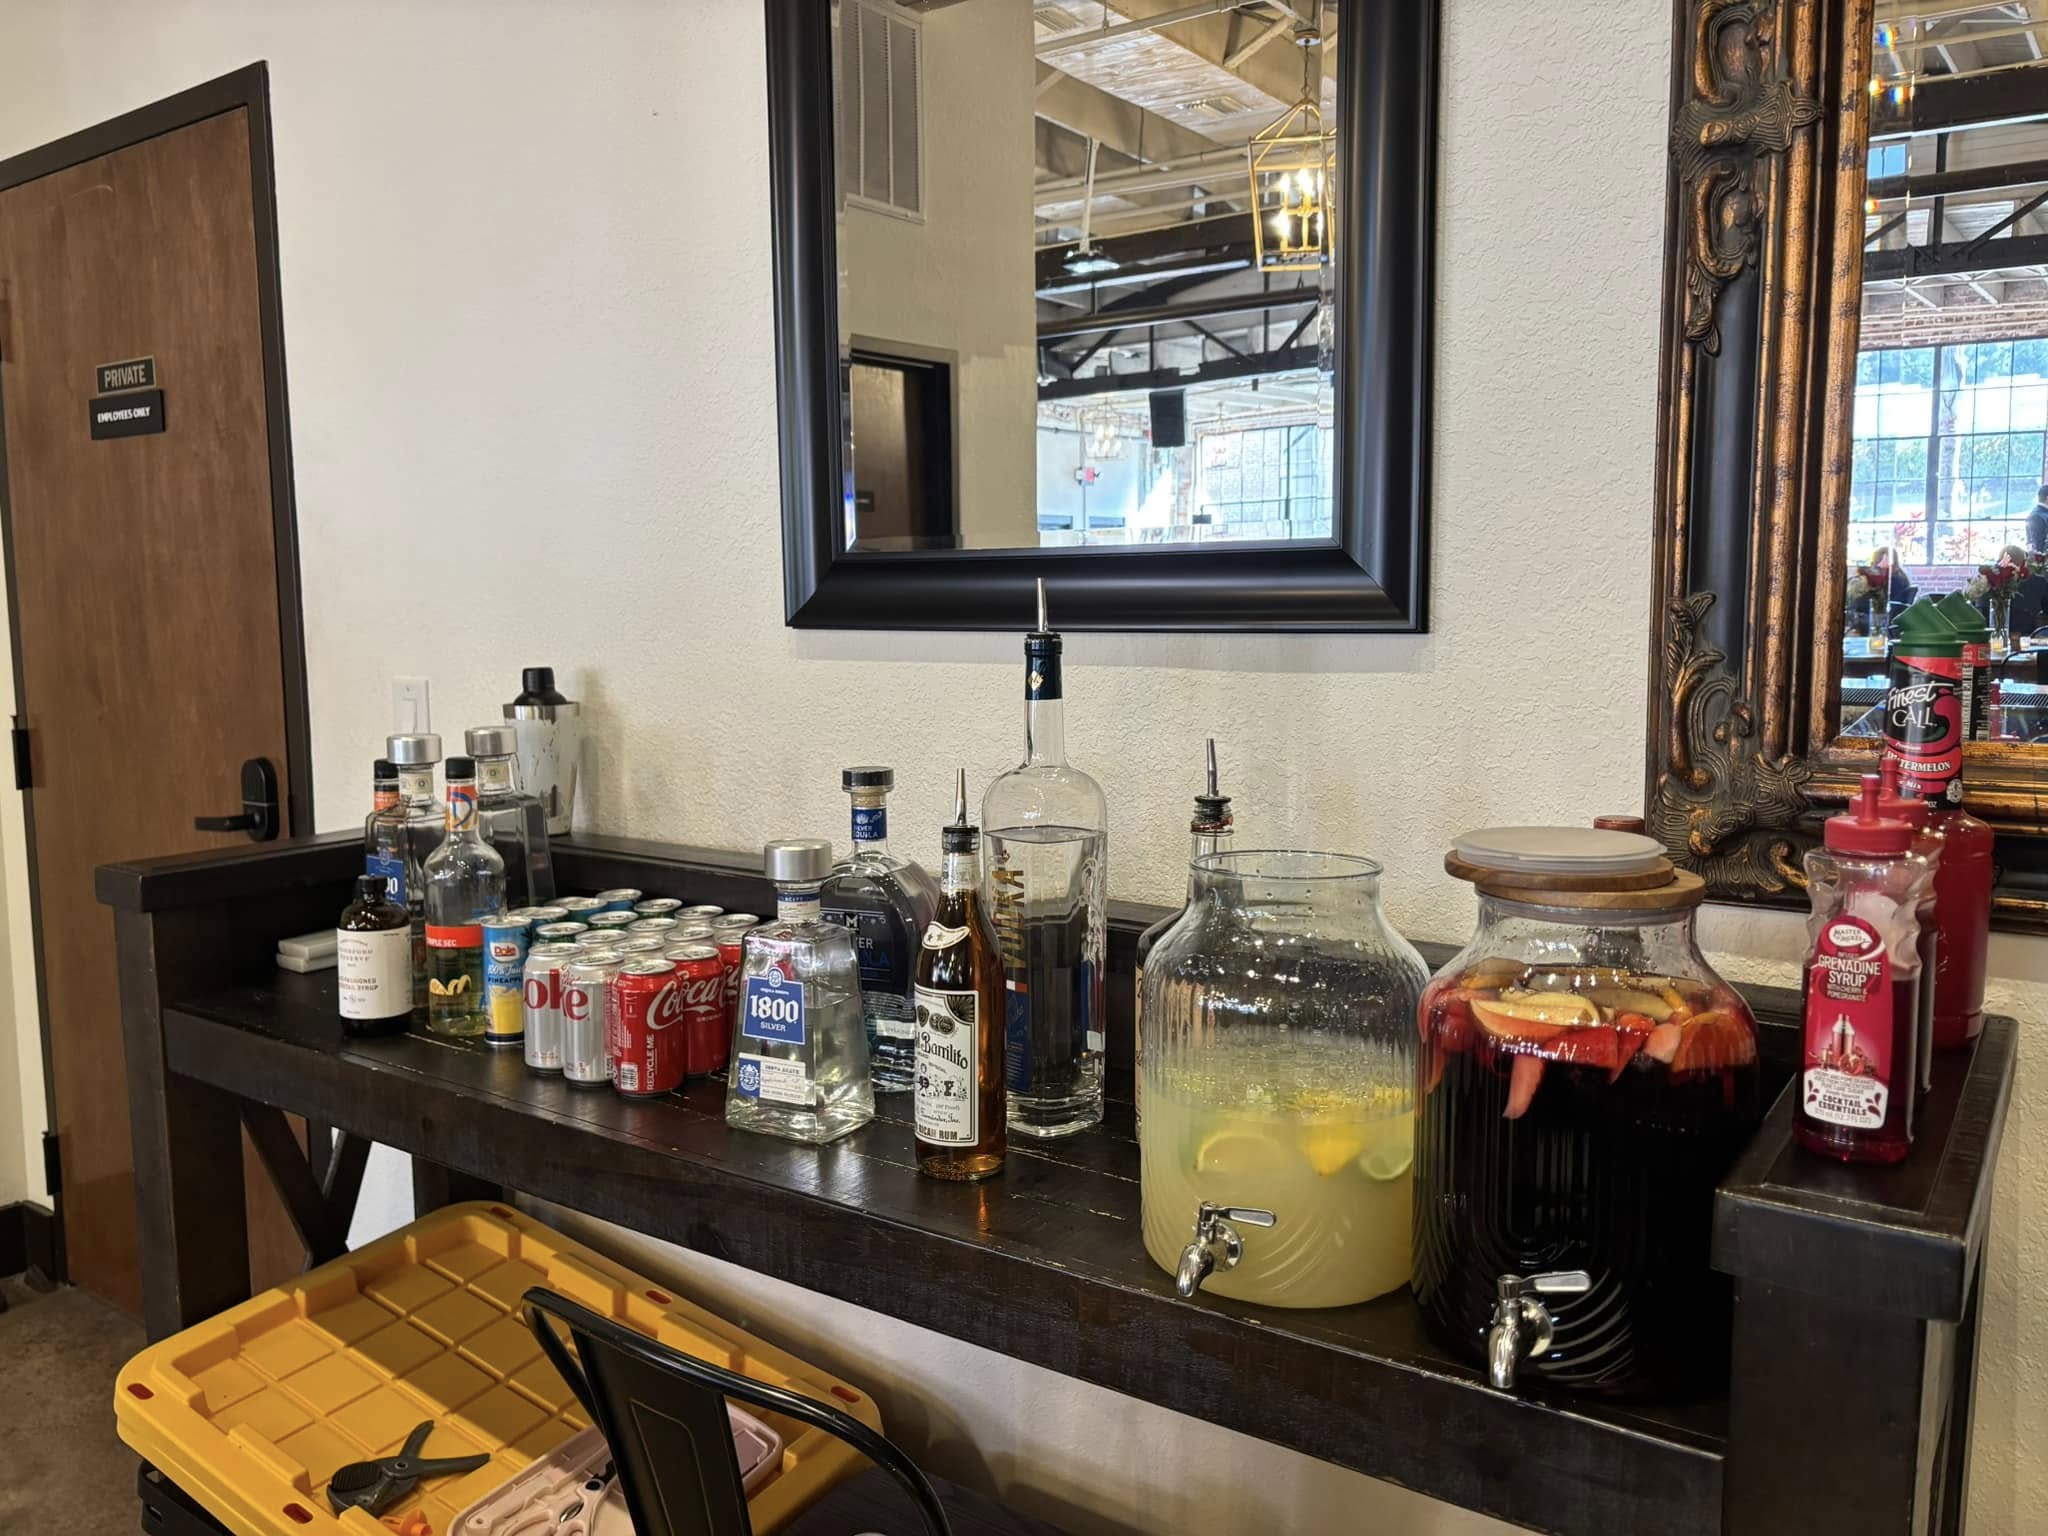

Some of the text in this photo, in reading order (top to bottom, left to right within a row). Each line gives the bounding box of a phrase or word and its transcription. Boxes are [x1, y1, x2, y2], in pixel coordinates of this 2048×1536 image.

[104, 364, 146, 389] PRIVATE
[97, 406, 151, 423] EMPLOYEES ONLY
[1888, 681, 1954, 711] Finest
[1892, 704, 1933, 728] CALL
[1887, 751, 1951, 772] WTERMELON
[494, 944, 517, 957] Dole
[1818, 954, 1882, 975] GRENADINE
[1828, 970, 1867, 987] SYRUP
[750, 994, 799, 1024] 1800
[760, 1020, 786, 1032] SILVER
[921, 1031, 968, 1070] Barrilito
[646, 1033, 656, 1090] RECYCLE ME
[1818, 1101, 1867, 1116] ESSENTIALS
[1823, 1094, 1862, 1108] COCKTAIL
[938, 1130, 958, 1140] RUM
